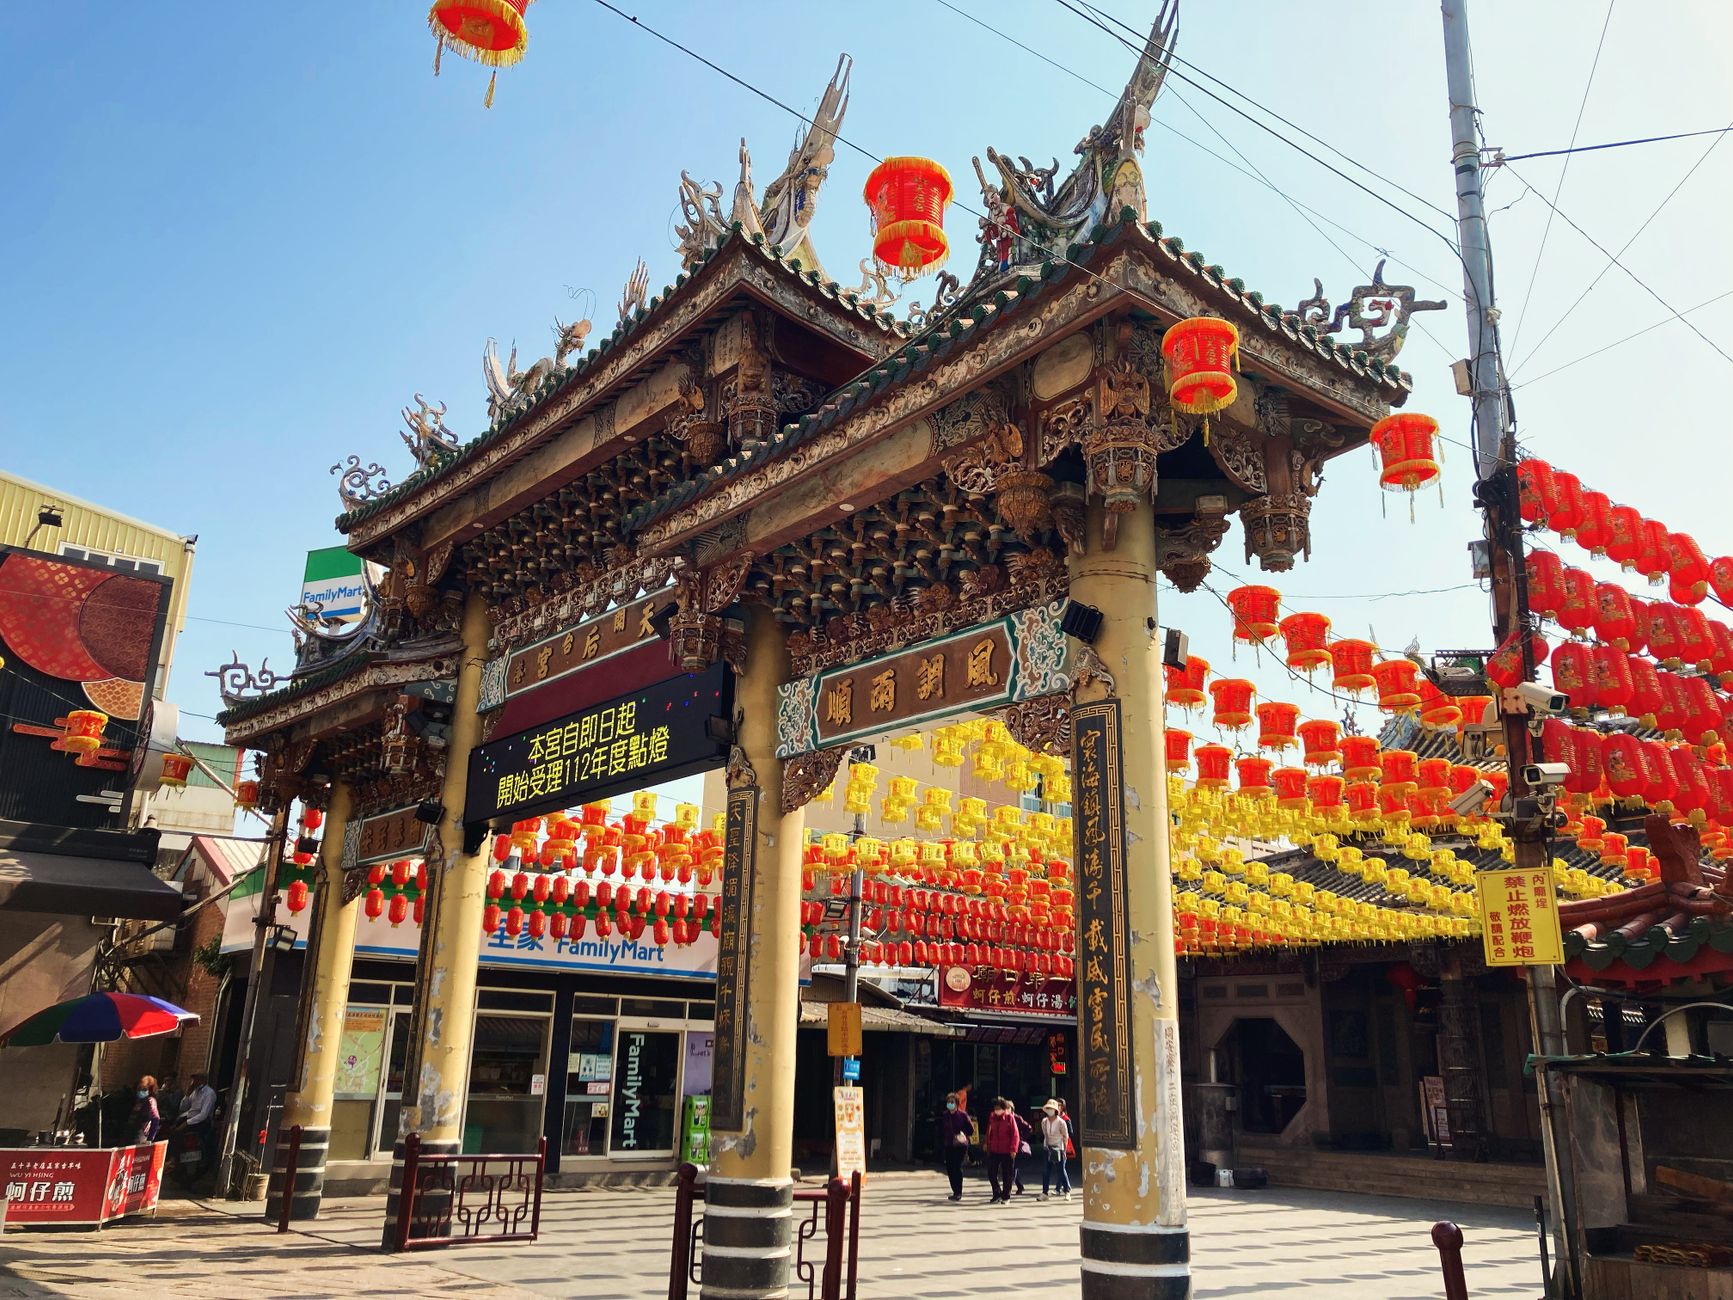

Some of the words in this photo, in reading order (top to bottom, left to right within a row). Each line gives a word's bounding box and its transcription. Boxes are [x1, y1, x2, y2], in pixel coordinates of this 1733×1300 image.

[303, 585, 362, 603] FamilyMart
[528, 701, 636, 763] 本宮自即日起
[497, 726, 671, 809] 開始受理112年度點燈
[1490, 911, 1506, 958] 敬請配合
[1504, 876, 1535, 958] 禁止燃放鞭炮
[556, 936, 664, 963] FamilyMart
[622, 1033, 645, 1147] FamilyMart
[5, 1181, 75, 1202] 蚵仔煎
